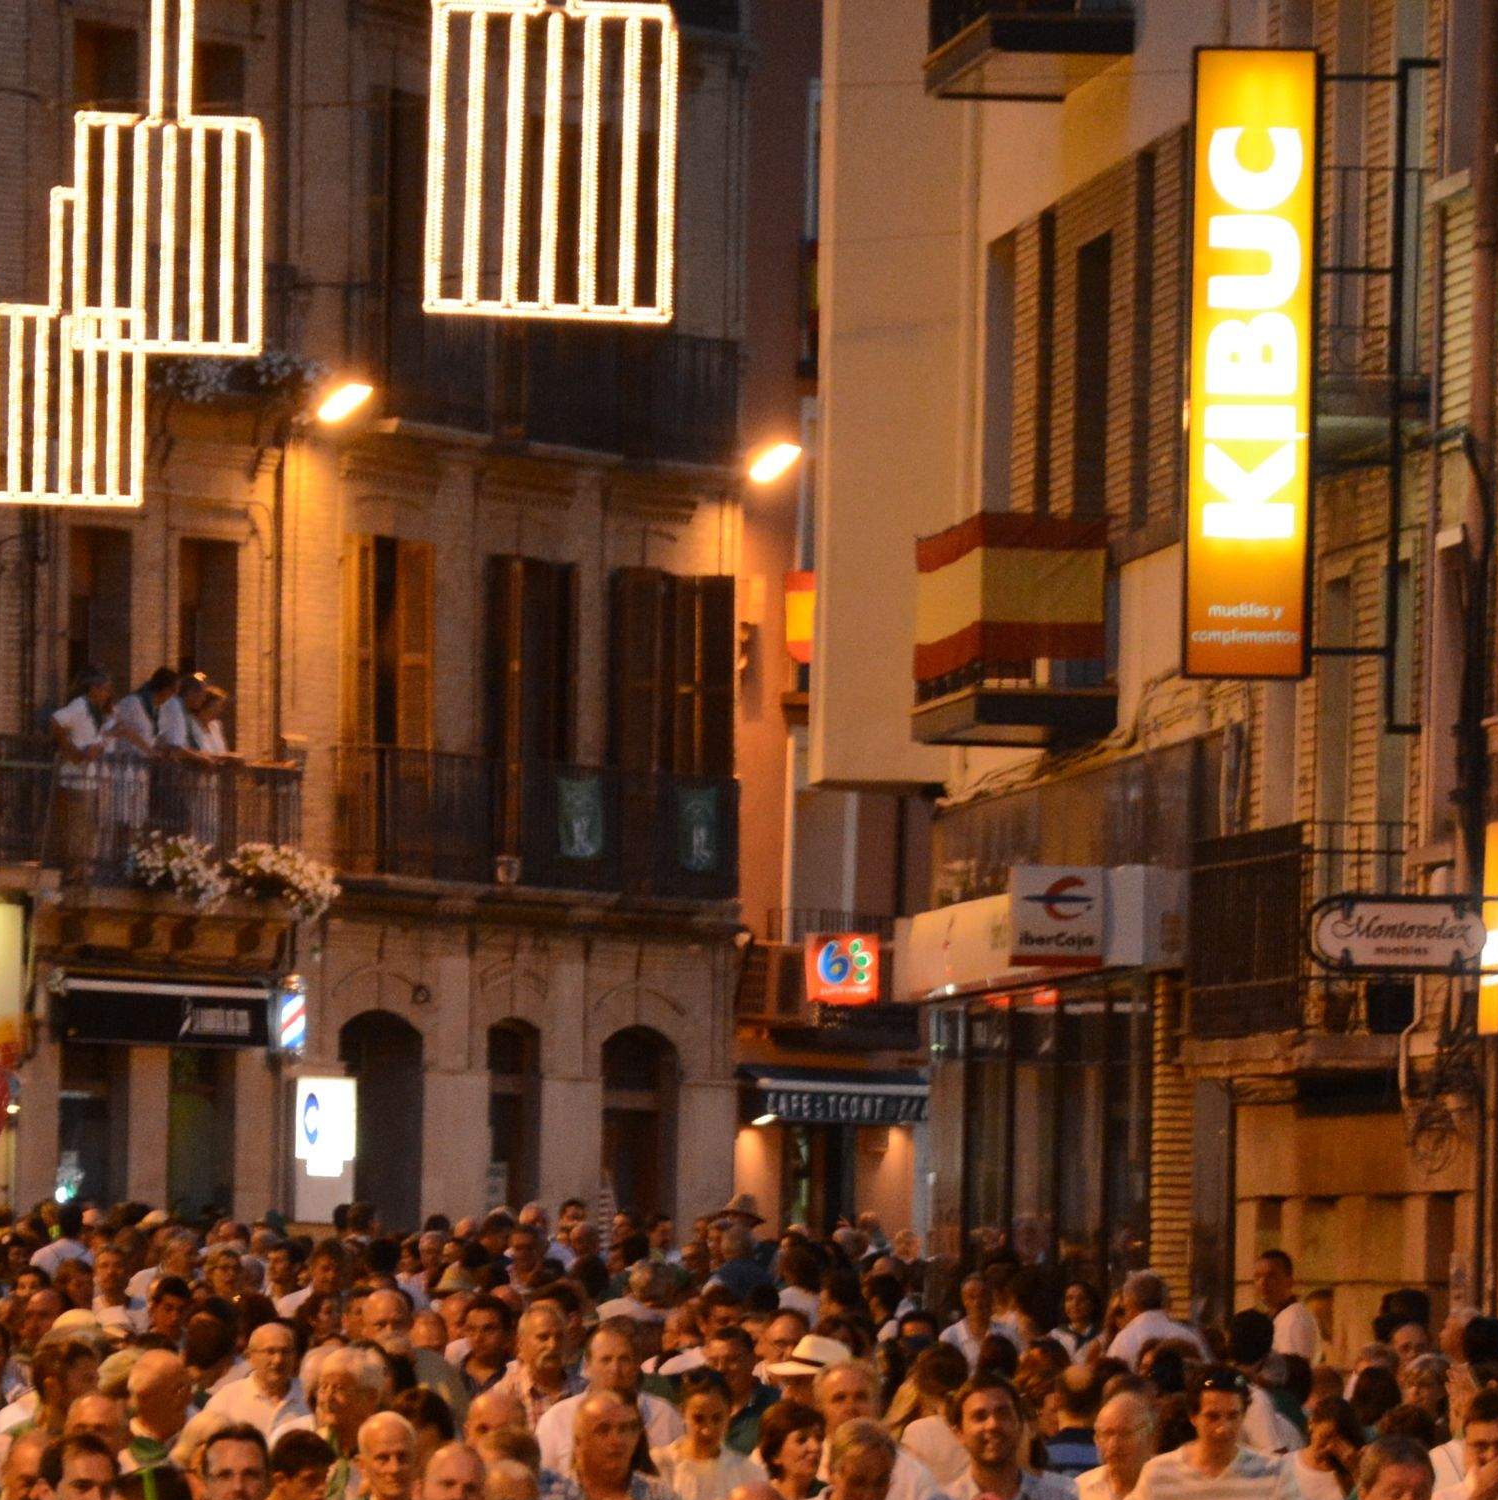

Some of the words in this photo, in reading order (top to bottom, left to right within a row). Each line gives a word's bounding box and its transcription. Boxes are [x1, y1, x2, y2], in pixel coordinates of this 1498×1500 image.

[1202, 126, 1303, 538] KIBUC
[1209, 603, 1267, 619] muebles
[1271, 604, 1284, 621] y
[1191, 628, 1300, 646] complementos
